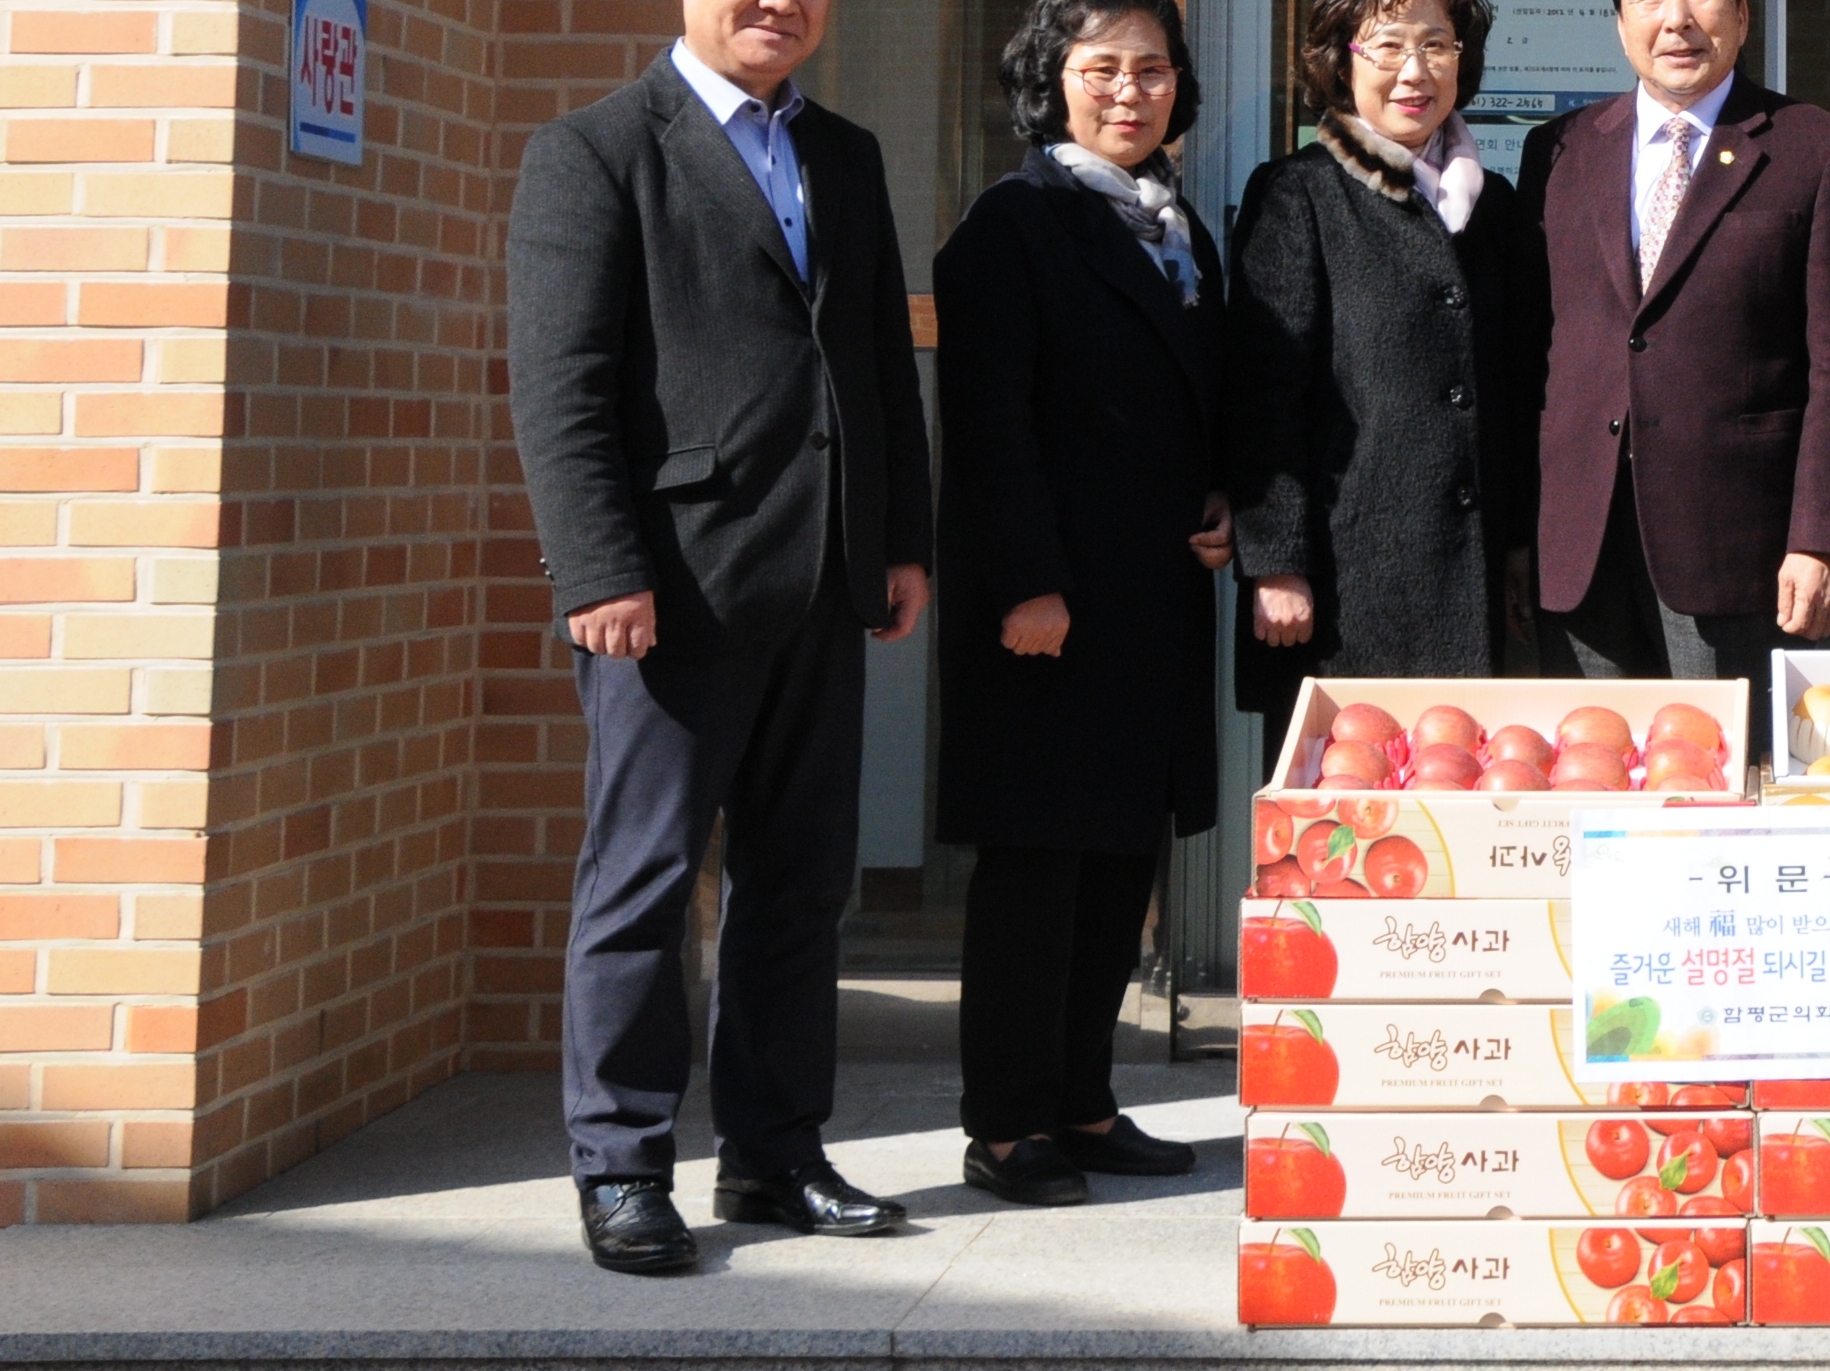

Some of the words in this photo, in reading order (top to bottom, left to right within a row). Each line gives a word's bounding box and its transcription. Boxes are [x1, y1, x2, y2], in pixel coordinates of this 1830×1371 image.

[300, 14, 357, 116] 사랑관
[1662, 916, 1701, 938] 새해
[1708, 909, 1737, 937] 福
[1746, 915, 1785, 936] 많이
[1609, 951, 1676, 986] 즐거운
[1681, 947, 1757, 986] 설명절
[1761, 948, 1827, 983] 되시길
[1379, 970, 1426, 979] PREMIUM
[1428, 970, 1457, 979] FRUIT
[1459, 970, 1482, 979] GIFT
[1485, 970, 1502, 979] SET
[1381, 1079, 1428, 1088] PREMIUM
[1430, 1079, 1458, 1088] FRUIT
[1461, 1079, 1484, 1088] GIFT
[1486, 1079, 1504, 1088] SET
[1388, 1191, 1436, 1200] PREMIUM
[1438, 1191, 1467, 1200] FRUIT
[1469, 1191, 1492, 1200] GIFT
[1494, 1191, 1512, 1200] SET
[1379, 1298, 1426, 1307] PREMIUM
[1428, 1298, 1457, 1307] FRUIT
[1459, 1298, 1482, 1307] GIFT
[1484, 1298, 1502, 1307] SET
